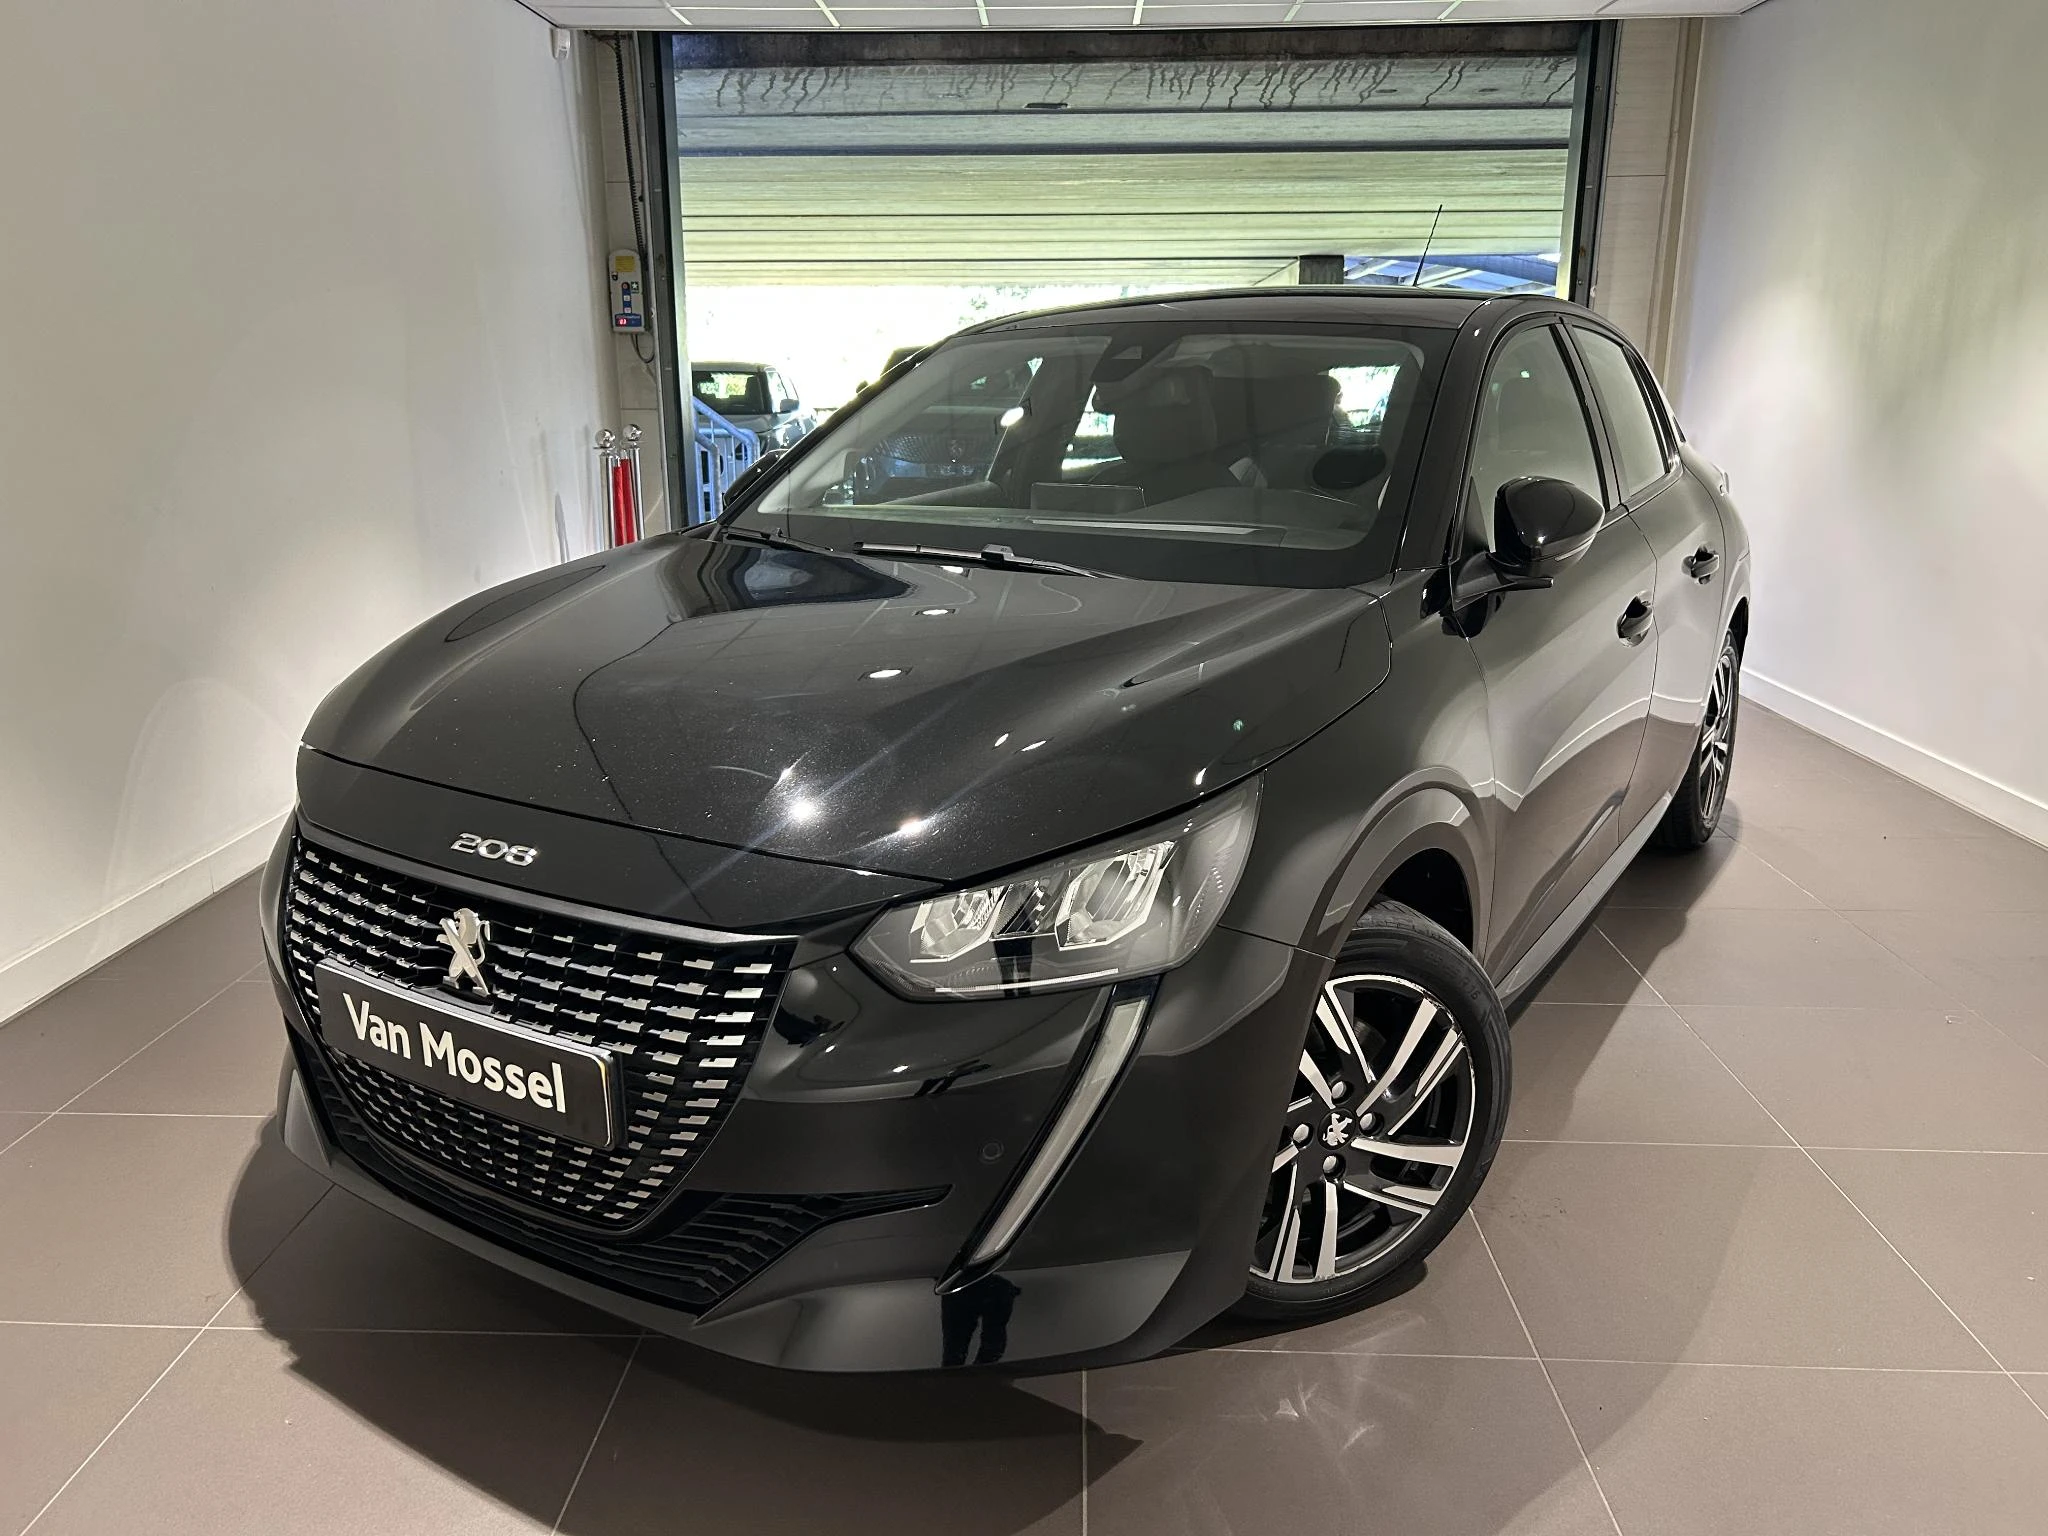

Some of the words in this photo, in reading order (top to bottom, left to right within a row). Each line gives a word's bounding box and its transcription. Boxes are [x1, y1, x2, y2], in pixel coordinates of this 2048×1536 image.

[450, 832, 540, 867] 208
[342, 991, 412, 1060] Van
[419, 1021, 567, 1114] Mossel
